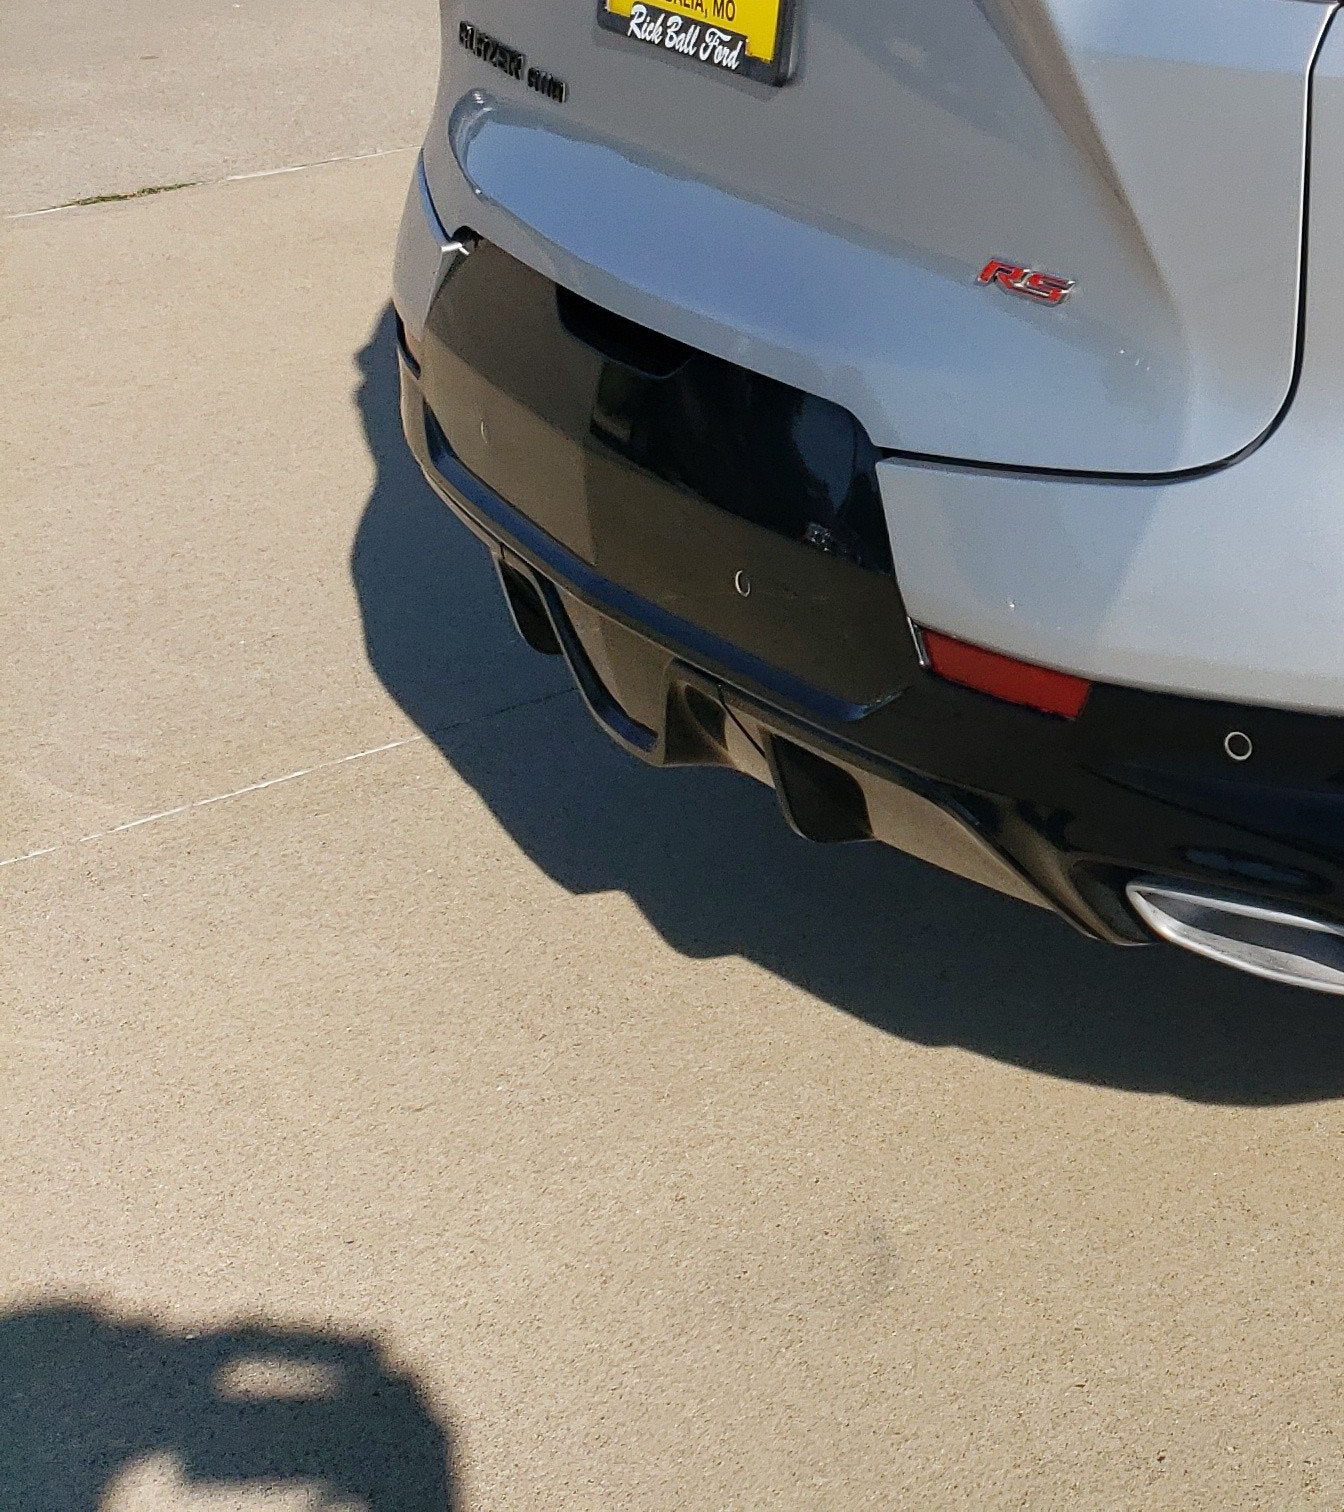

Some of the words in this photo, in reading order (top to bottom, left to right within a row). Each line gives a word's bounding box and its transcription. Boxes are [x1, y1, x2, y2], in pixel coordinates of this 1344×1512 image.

[627, 4, 665, 44] Rick
[664, 15, 701, 56] Ball
[700, 28, 744, 70] Ford
[976, 257, 1077, 307] RS
